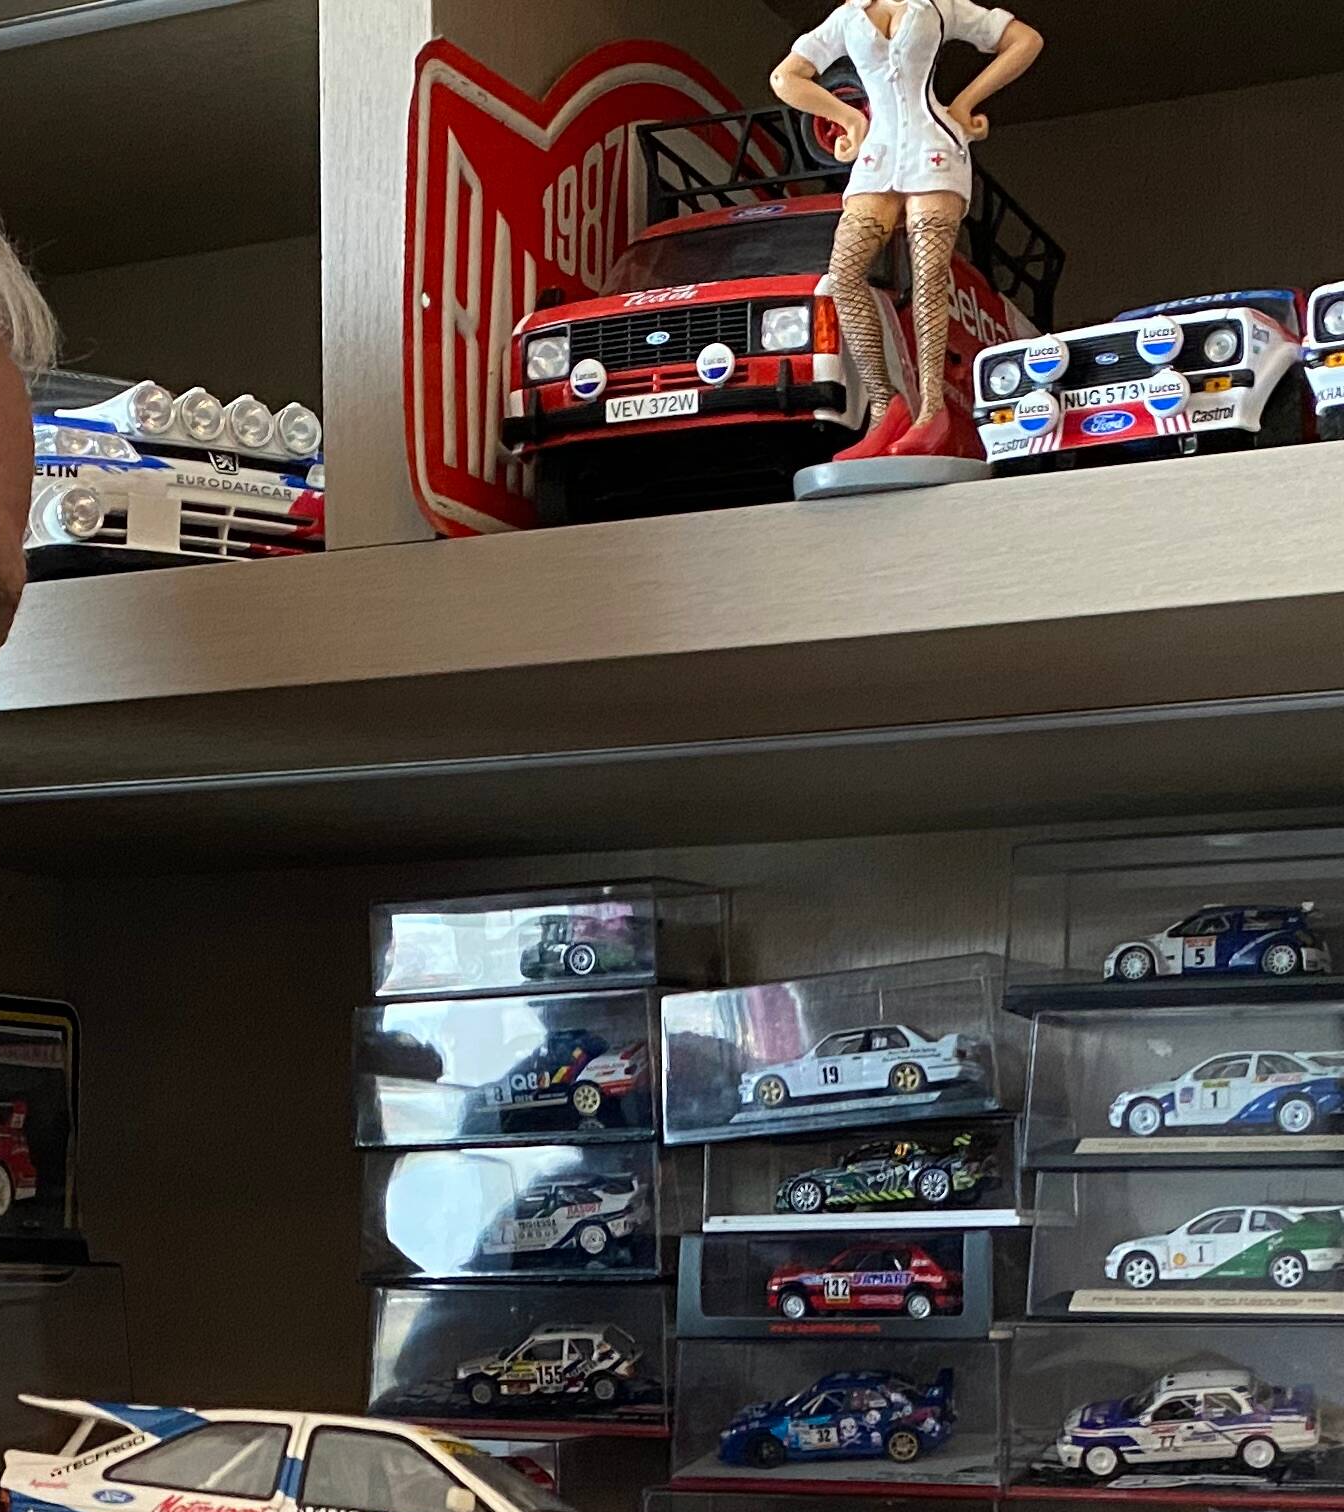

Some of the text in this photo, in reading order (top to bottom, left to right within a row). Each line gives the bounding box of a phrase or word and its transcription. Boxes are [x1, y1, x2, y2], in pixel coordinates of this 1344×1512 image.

[542, 125, 625, 295] 1987
[1142, 326, 1176, 338] Lucas
[1029, 344, 1060, 358] Lucas
[1063, 384, 1146, 409] NUG 573
[1149, 382, 1182, 394] Lucas
[610, 391, 696, 419] VEV 372W
[1018, 402, 1051, 414] Lucas
[1191, 405, 1235, 424] Castrol
[991, 436, 1029, 456] Castrol
[175, 473, 293, 500] EURODATACAR
[1195, 949, 1206, 966] 5
[821, 1066, 840, 1085] 19
[824, 1278, 849, 1298] 132
[535, 1364, 563, 1386] 155
[816, 1428, 831, 1443] 32
